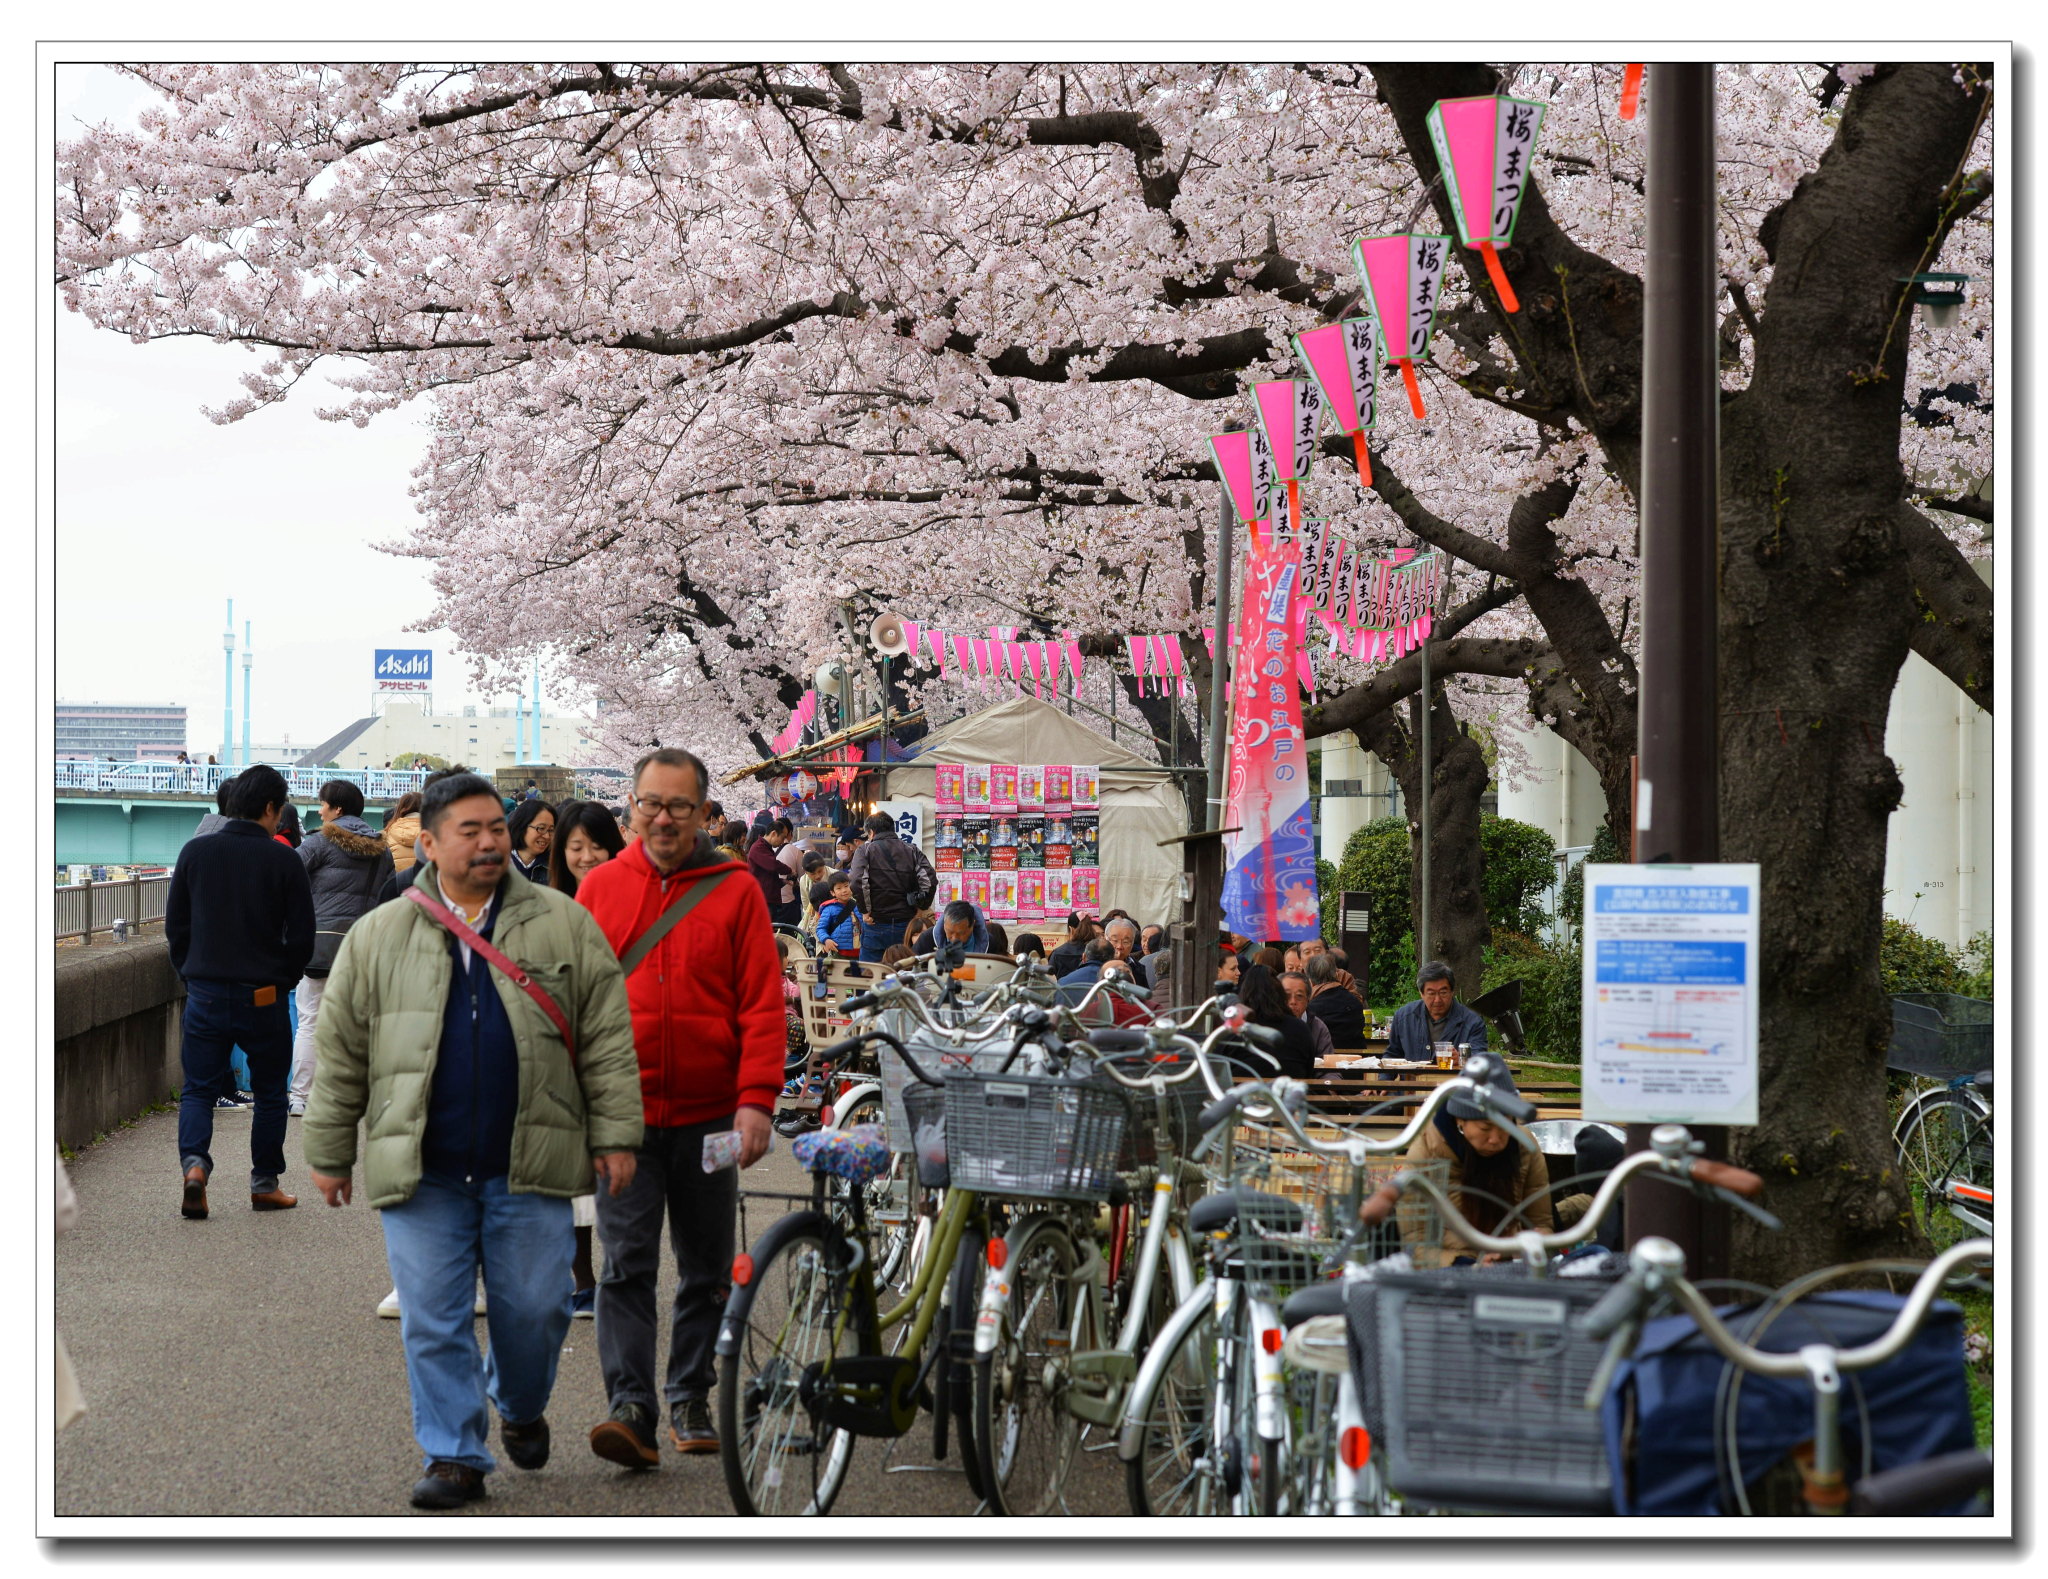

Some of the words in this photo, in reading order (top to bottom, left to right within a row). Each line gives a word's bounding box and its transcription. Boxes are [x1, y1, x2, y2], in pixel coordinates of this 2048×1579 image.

[1495, 104, 1533, 236] 桜まつり
[1411, 240, 1441, 355] 桜まつり
[1351, 322, 1375, 425] 桜まつり
[1296, 382, 1319, 477] 桜まつり
[1302, 521, 1320, 592] 桜まつり
[1357, 563, 1370, 624] 桜まつり
[378, 654, 428, 674] Asahi
[379, 681, 427, 690] アサヒビール
[1265, 628, 1297, 783] 花のお江戸の
